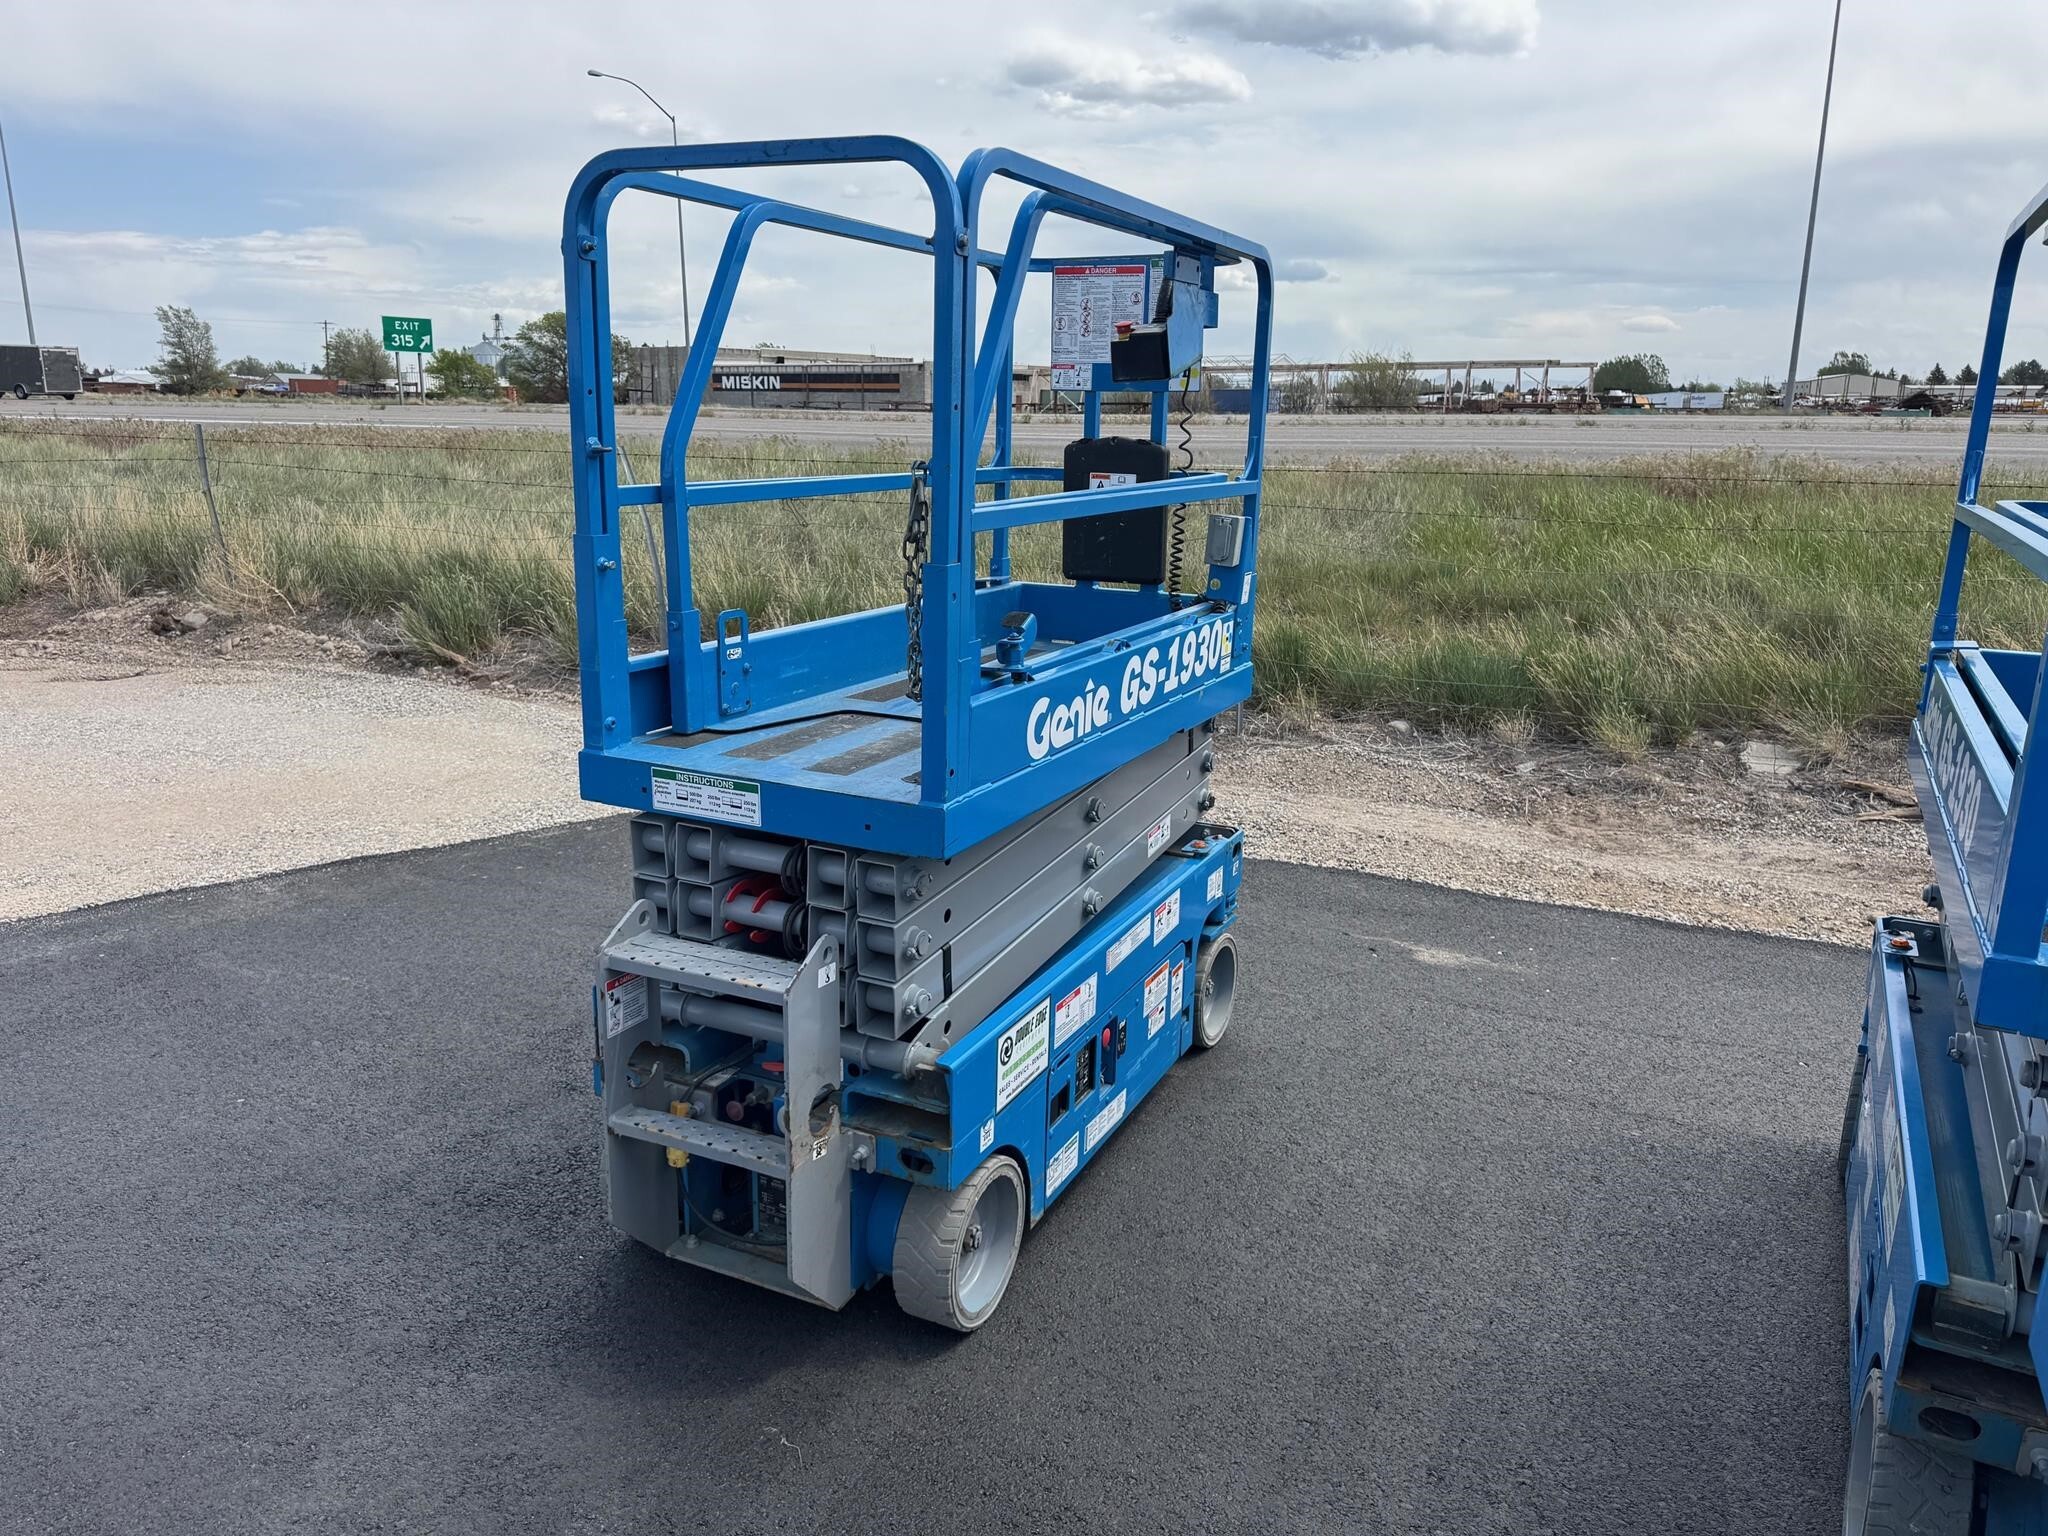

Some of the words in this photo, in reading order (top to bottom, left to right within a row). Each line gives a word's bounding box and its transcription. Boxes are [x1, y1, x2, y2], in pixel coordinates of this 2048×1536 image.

[394, 320, 419, 331] EXIT
[391, 333, 414, 347] 315
[721, 375, 780, 390] MISKIN
[1027, 677, 1111, 760] Genie
[1120, 619, 1223, 714] GS-1930
[675, 773, 734, 789] INSTRUCTIONS
[1035, 1004, 1048, 1029] EDGE
[998, 1080, 1011, 1096] SALES
